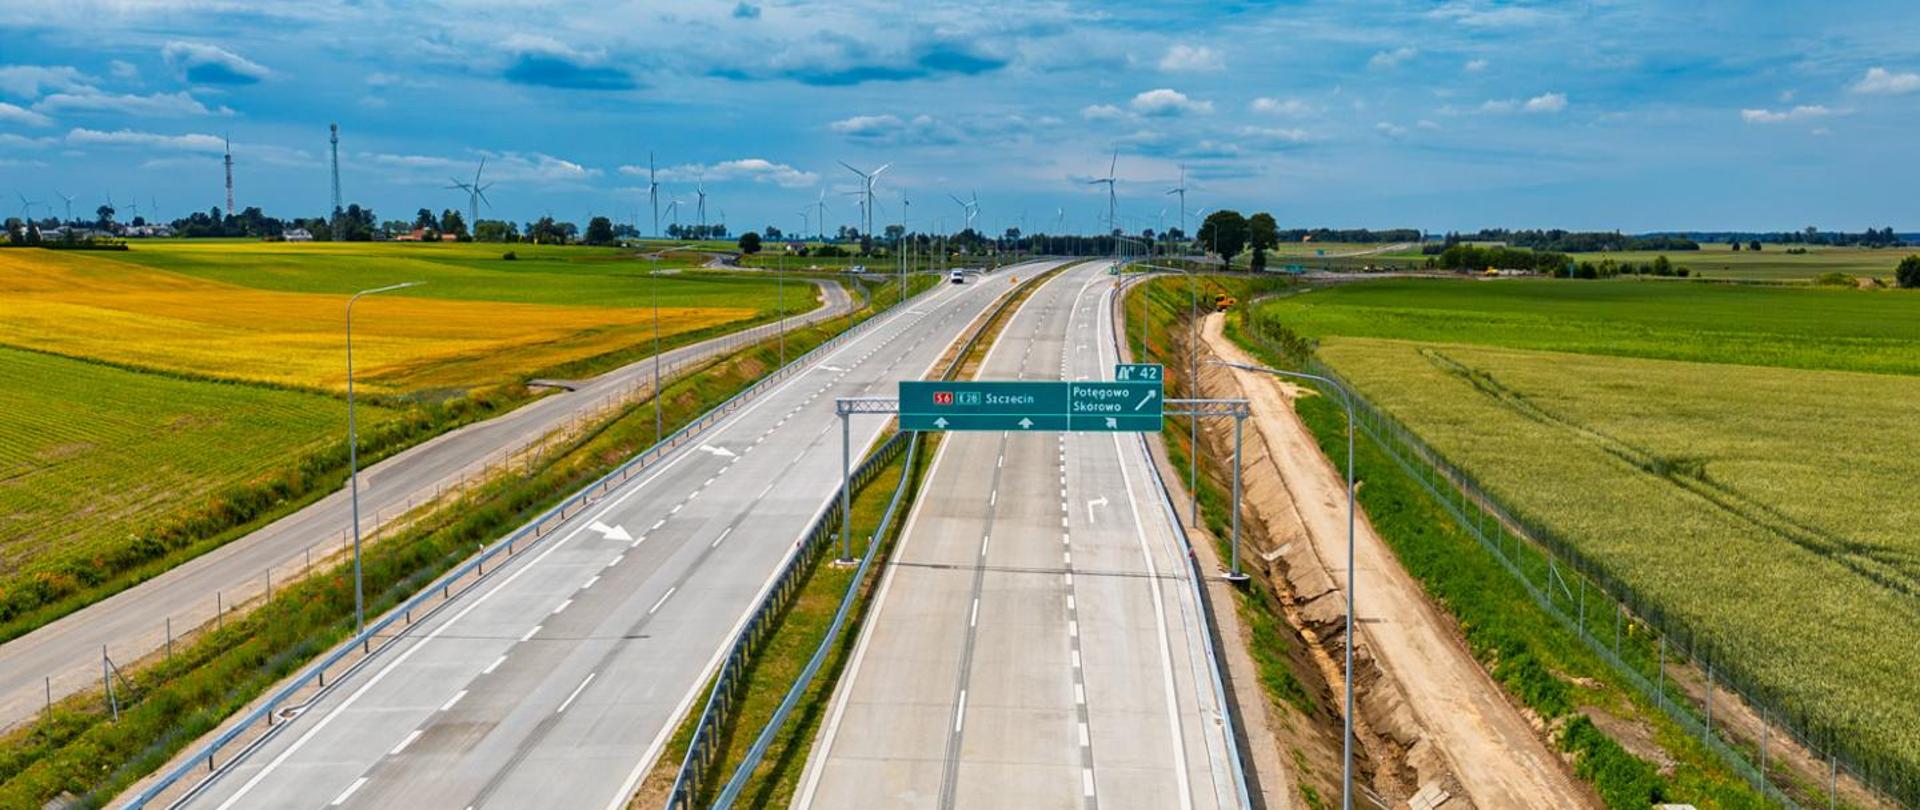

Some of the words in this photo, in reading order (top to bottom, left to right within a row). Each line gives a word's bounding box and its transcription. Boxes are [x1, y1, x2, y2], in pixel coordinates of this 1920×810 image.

[1139, 367, 1157, 379] 42
[985, 393, 1035, 404] Szczecin
[1073, 386, 1130, 400] Potęgowo
